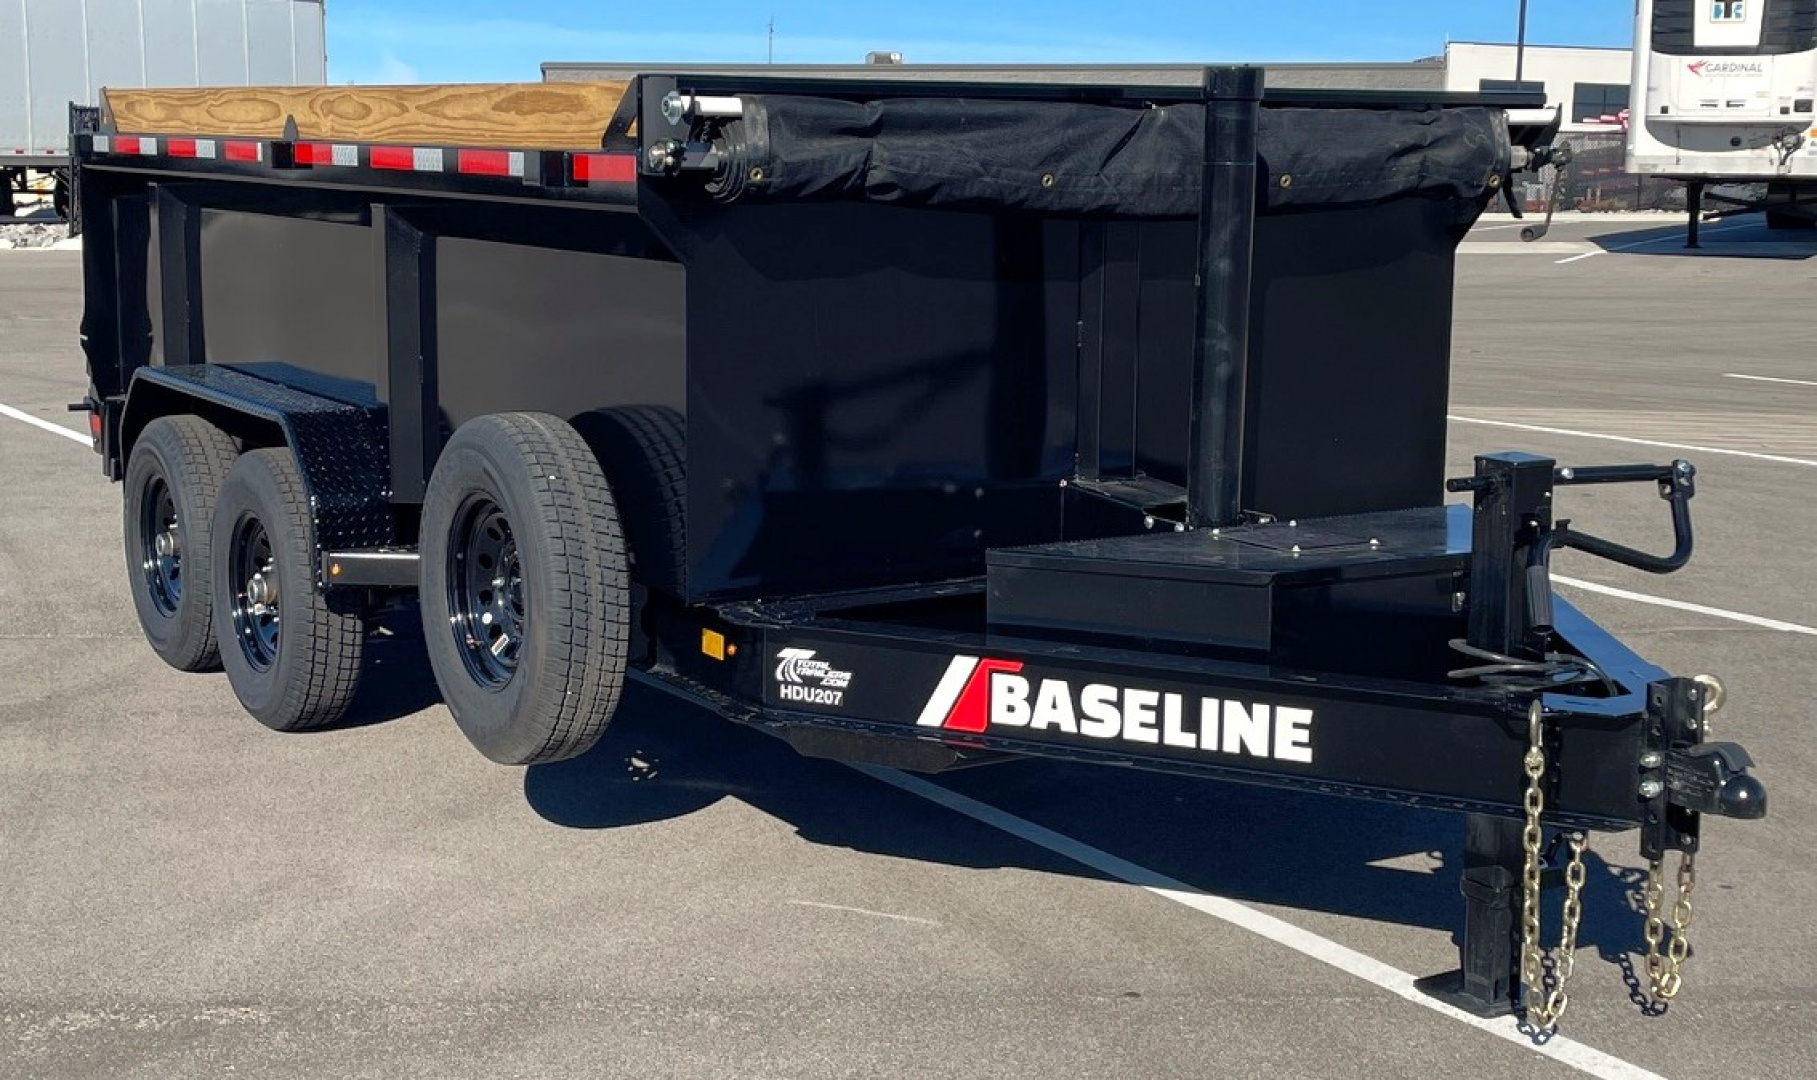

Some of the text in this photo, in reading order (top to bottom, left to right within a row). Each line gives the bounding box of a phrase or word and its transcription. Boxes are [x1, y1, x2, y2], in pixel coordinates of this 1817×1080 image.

[1705, 63, 1763, 73] CARDINAL
[797, 659, 831, 670] TOTAL
[796, 667, 852, 679] TRAILERS
[779, 684, 842, 705] HDU207
[991, 673, 1313, 763] BASELINE
